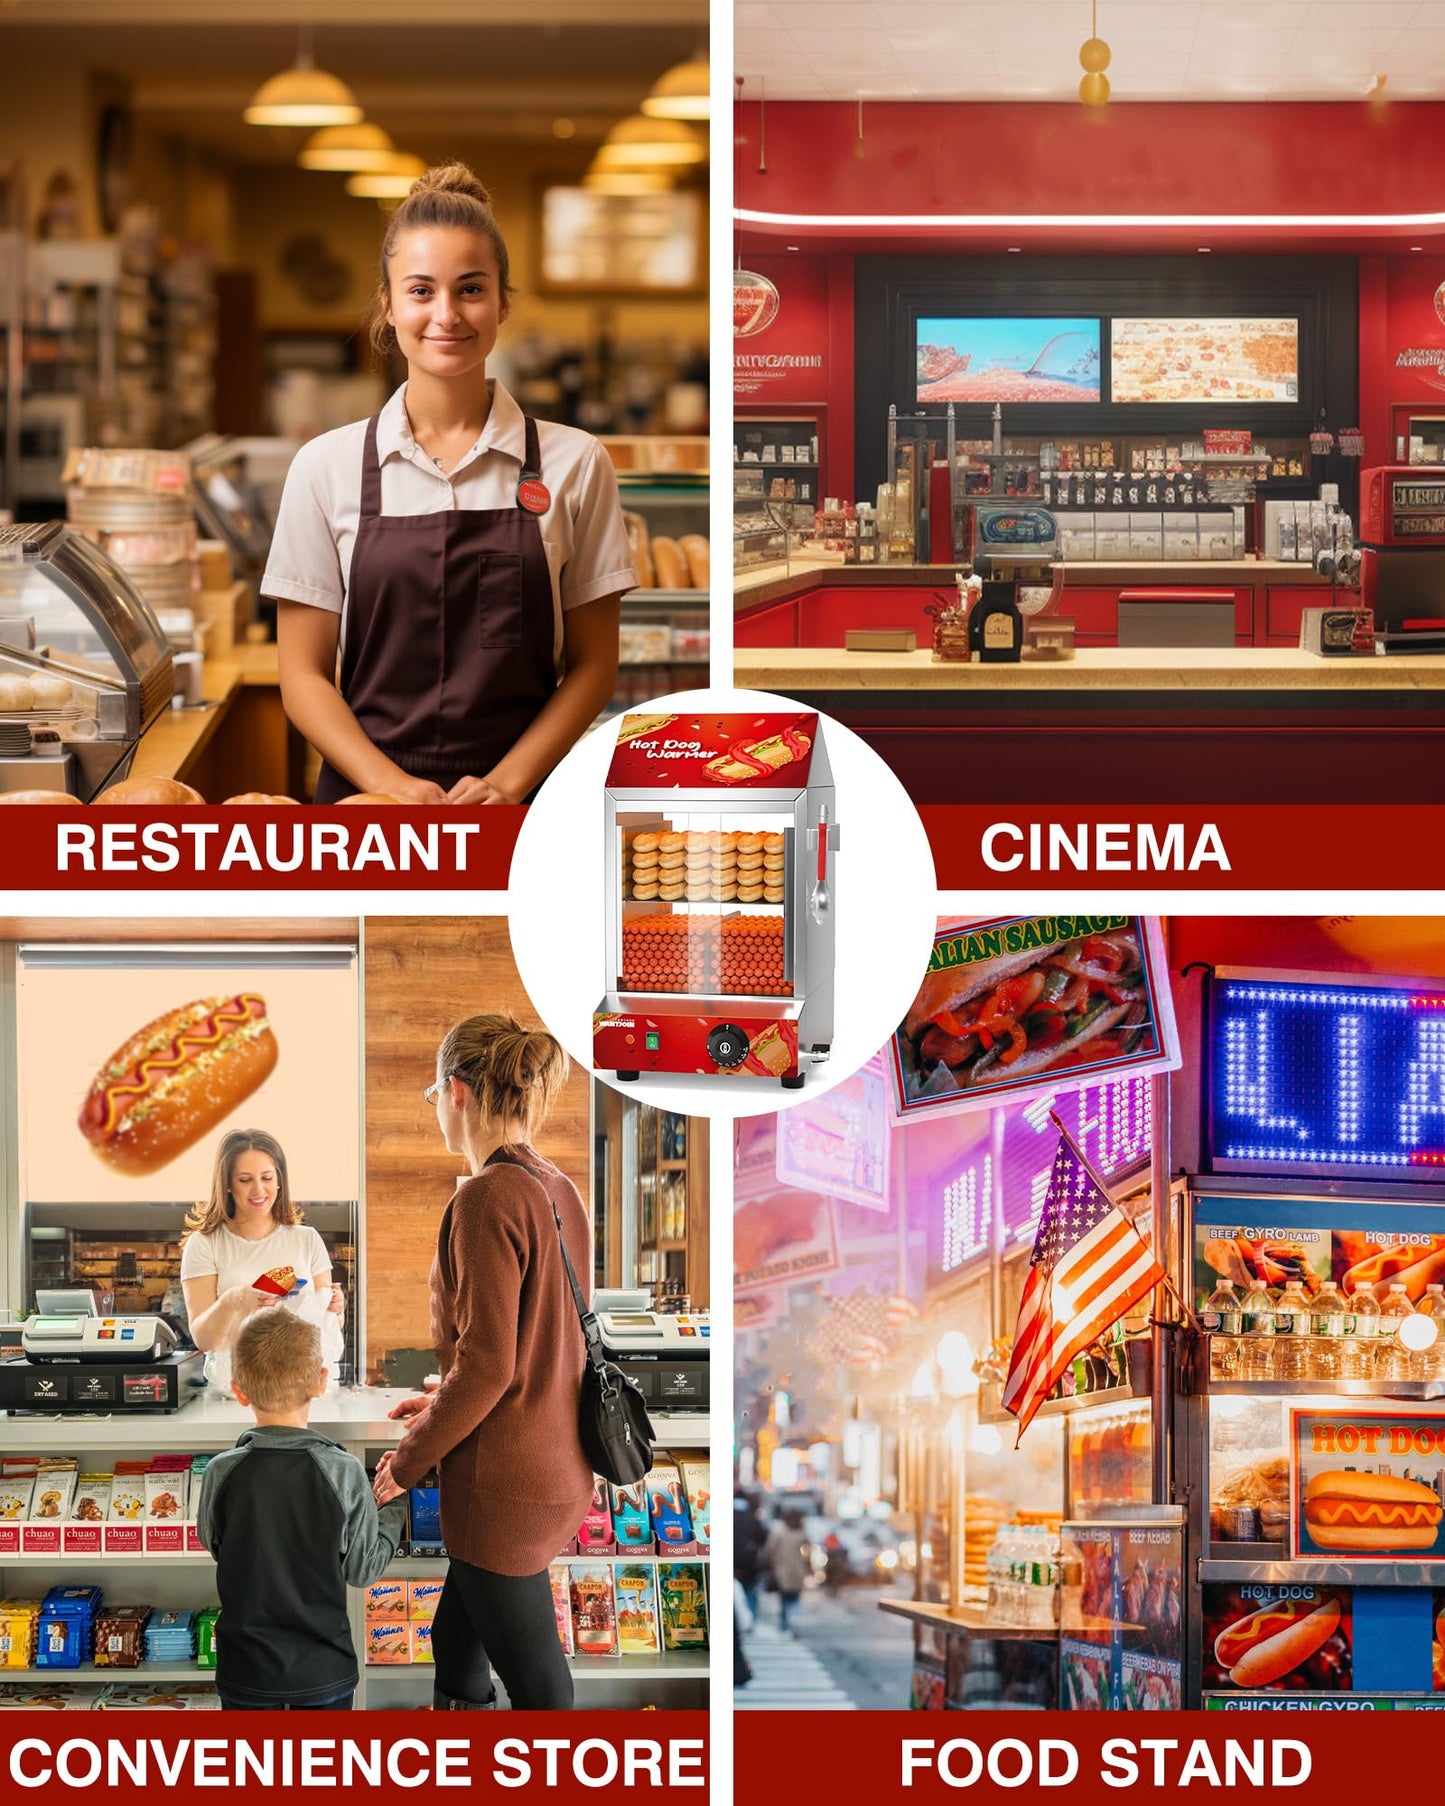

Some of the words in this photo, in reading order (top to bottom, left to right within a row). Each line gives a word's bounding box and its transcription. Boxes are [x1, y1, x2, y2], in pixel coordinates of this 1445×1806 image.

[629, 740, 660, 750] Hot
[663, 740, 702, 752] Dog
[1004, 916, 1128, 954] SAUSAGE
[1210, 1229, 1239, 1239] BEEF
[1243, 1227, 1287, 1240] GYRO
[1289, 1232, 1321, 1243] LAMB
[1365, 1231, 1396, 1244] HOT
[1399, 1233, 1432, 1245] DOG
[1312, 1424, 1383, 1454] HOT
[25, 1528, 55, 1538] chuao
[66, 1528, 96, 1538] chuao
[107, 1528, 137, 1538] chuao
[148, 1528, 178, 1538] chuao
[1129, 1530, 1146, 1543] BEEF
[1147, 1530, 1171, 1544] KEBAB
[621, 1578, 645, 1587] CHAPON
[670, 1580, 694, 1588] CHAPON
[369, 1587, 402, 1598] Manner
[1240, 1586, 1273, 1600] HOT
[1279, 1586, 1315, 1600] DOG
[371, 1627, 405, 1640] Manner
